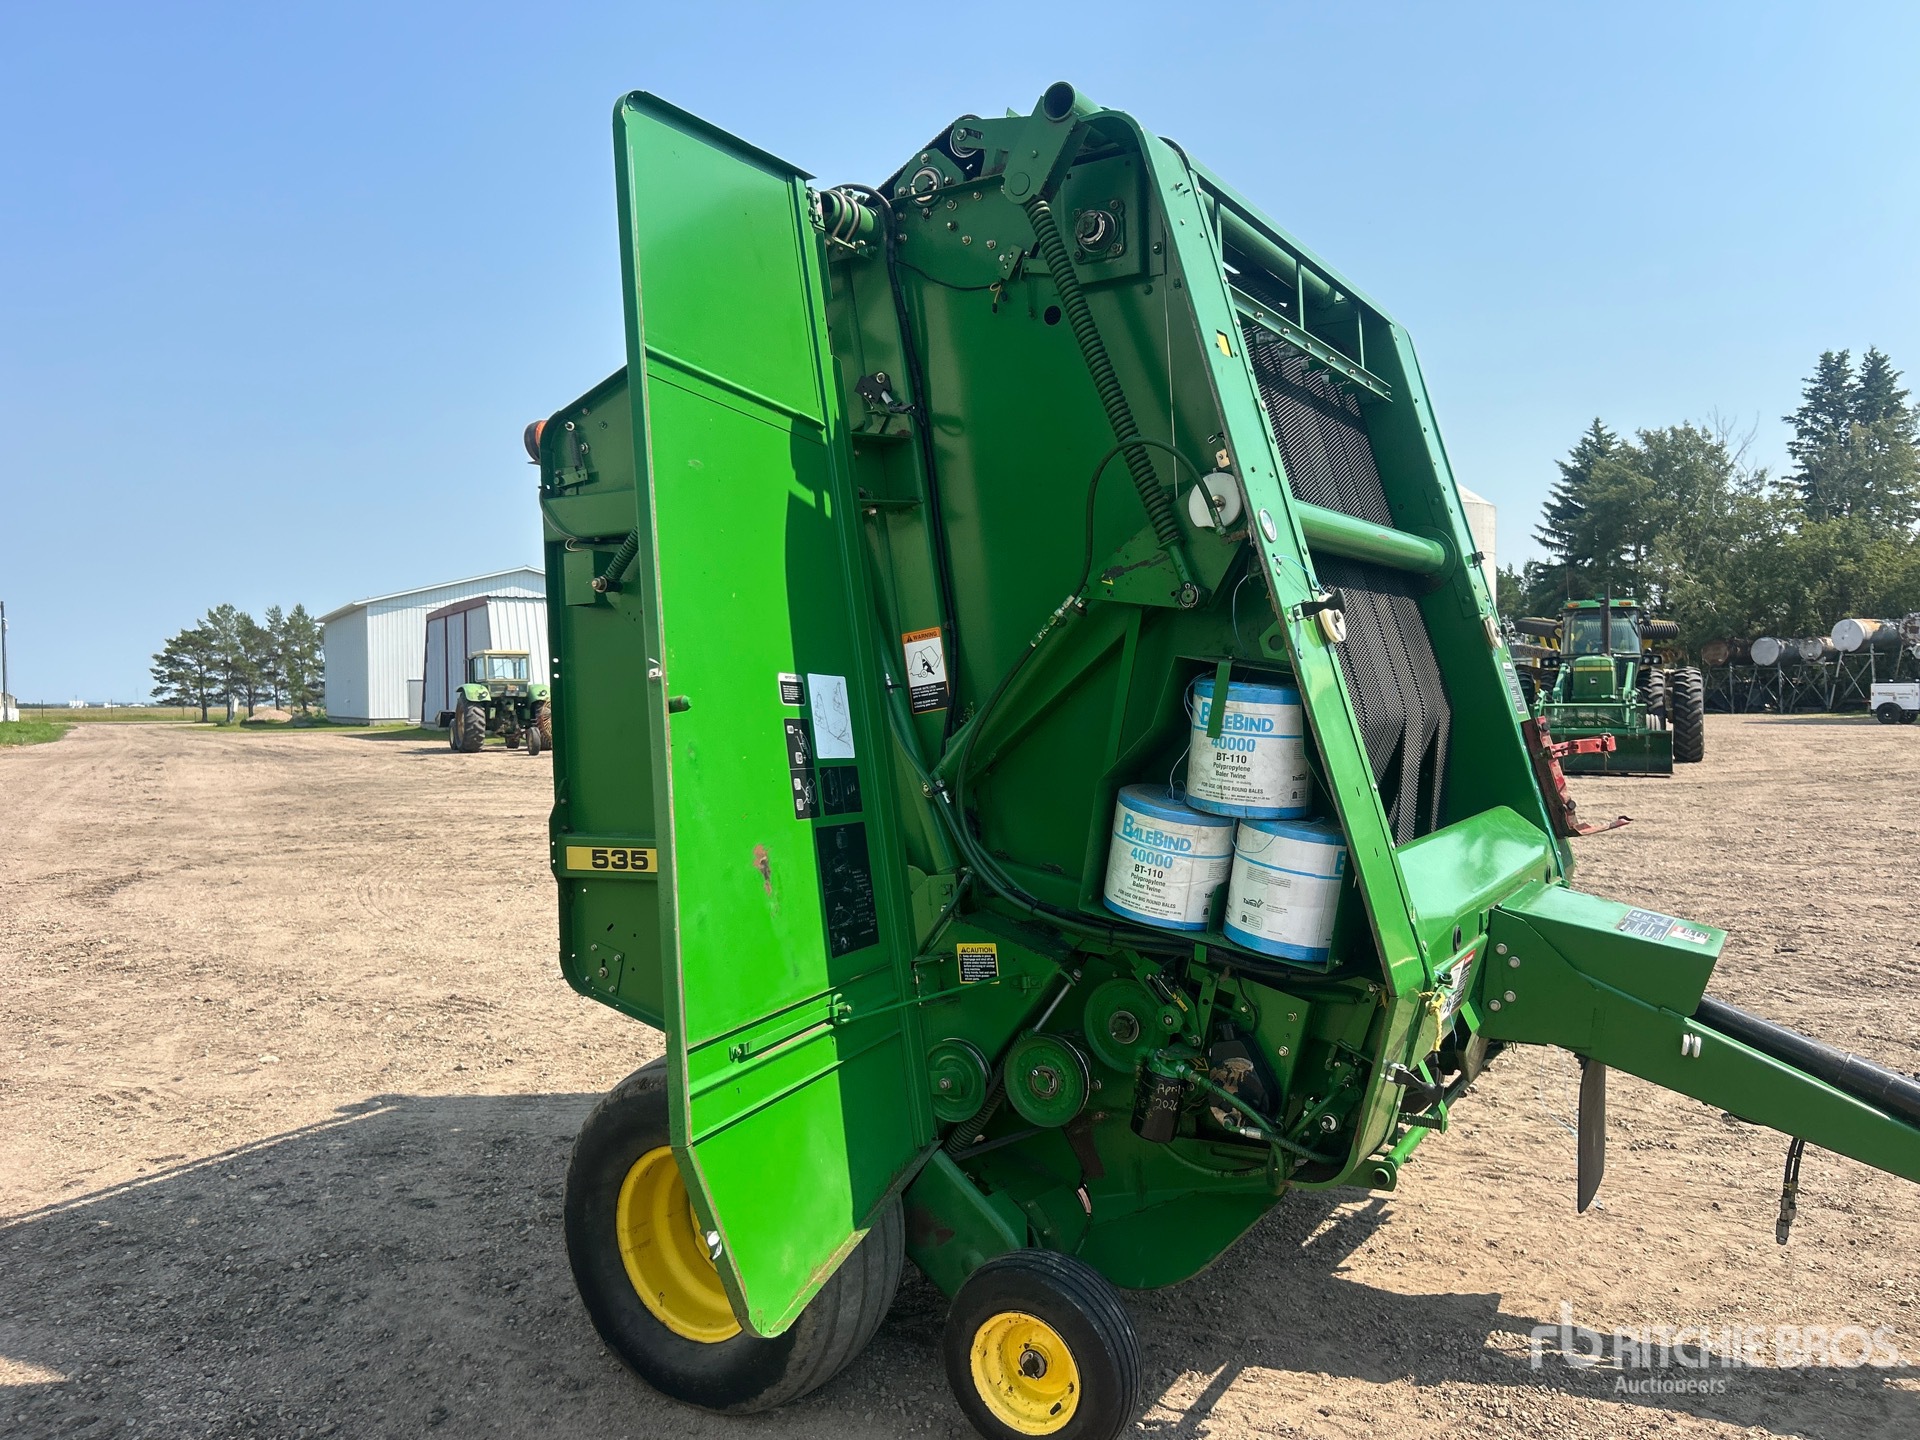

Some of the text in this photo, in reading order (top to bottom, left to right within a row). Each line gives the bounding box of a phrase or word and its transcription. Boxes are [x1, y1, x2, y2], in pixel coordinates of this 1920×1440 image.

[912, 630, 938, 640] WARNING
[1216, 752, 1247, 764] BT-110
[1212, 761, 1251, 772] Polypropylene
[1215, 770, 1247, 779] Baler Twine
[591, 849, 649, 870] 535
[1130, 847, 1174, 869] 40000
[1134, 863, 1164, 879] BT-110
[1130, 872, 1166, 887] Polypropylene
[1132, 881, 1146, 891] Baler
[1146, 884, 1162, 894] Twine
[1156, 1083, 1181, 1096] April
